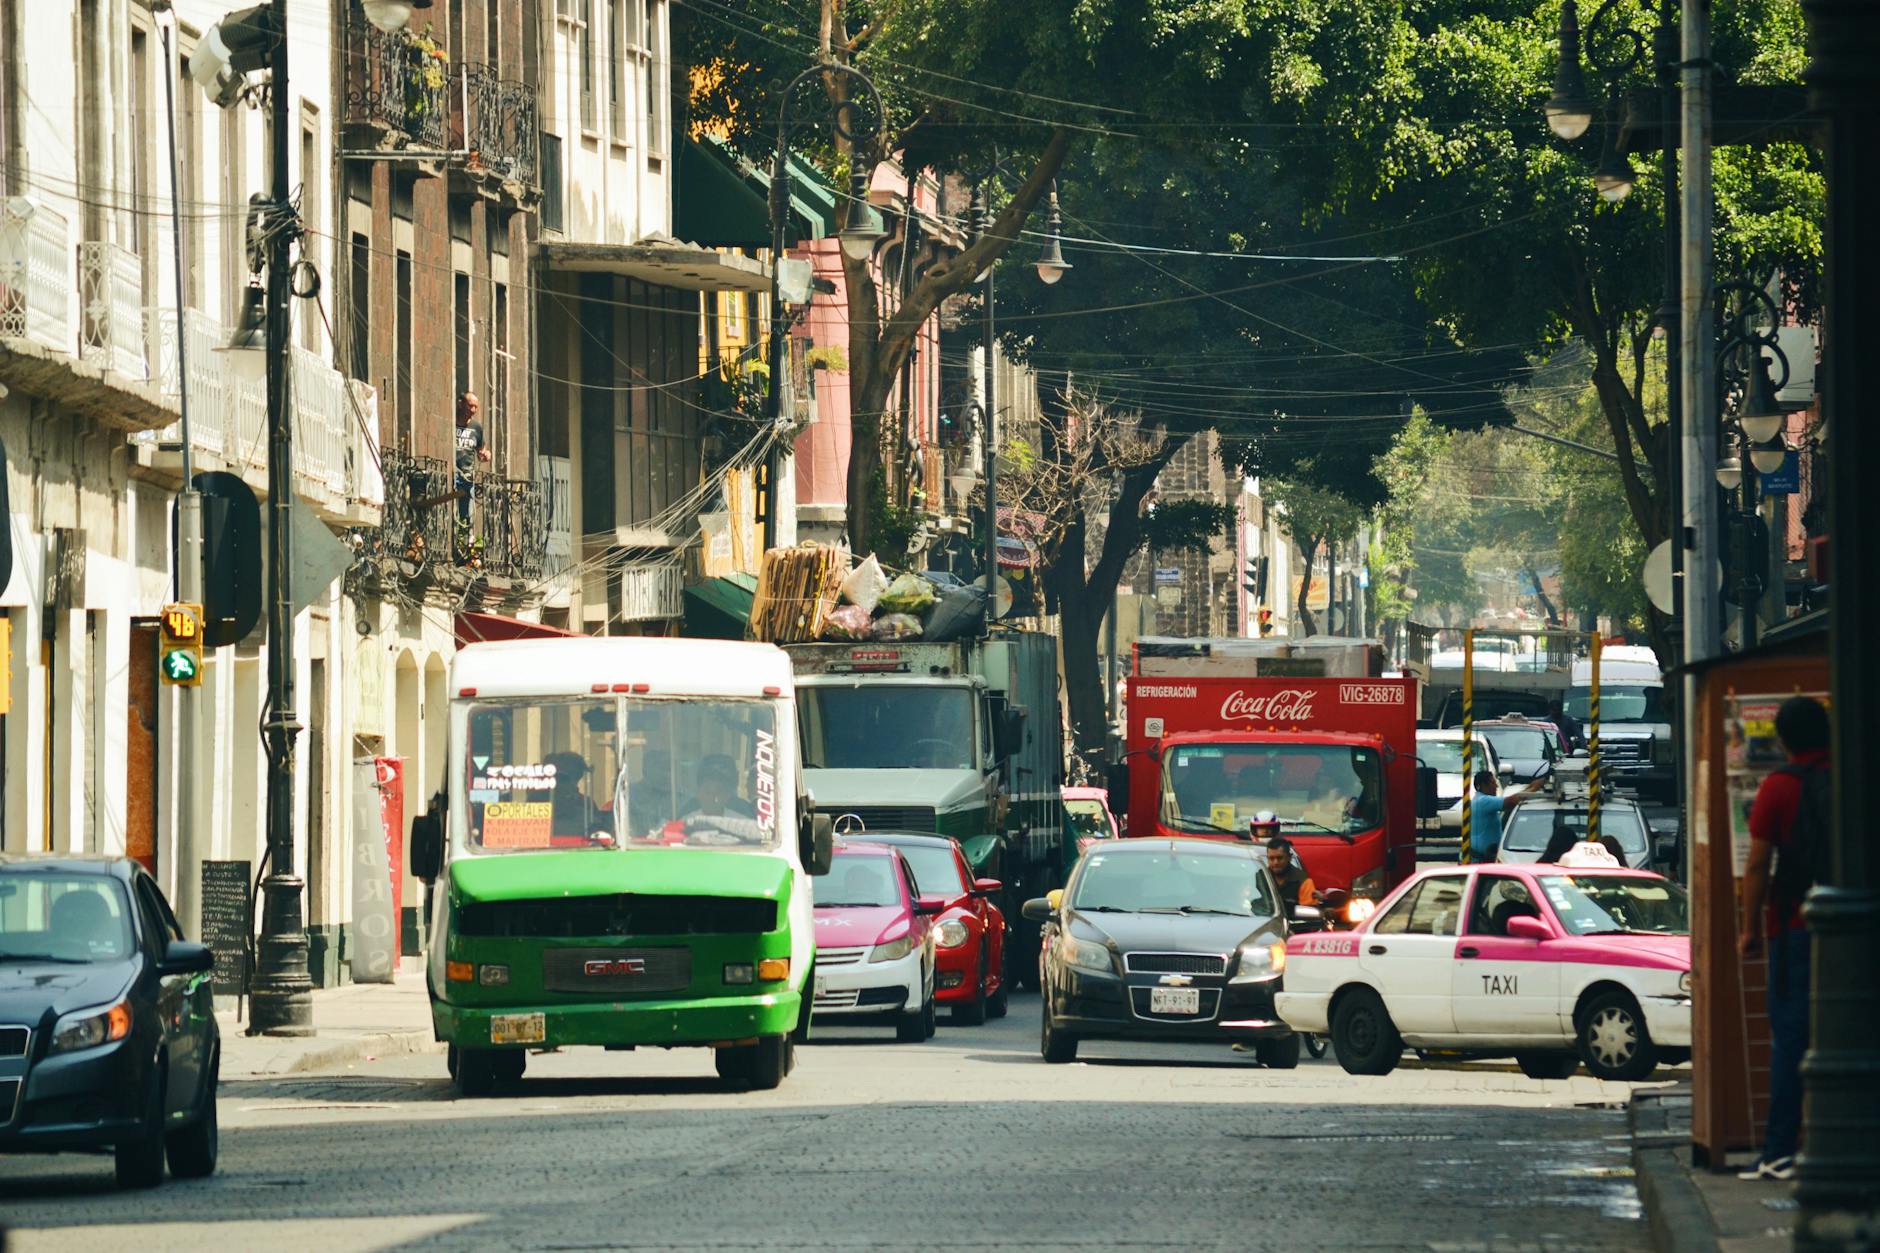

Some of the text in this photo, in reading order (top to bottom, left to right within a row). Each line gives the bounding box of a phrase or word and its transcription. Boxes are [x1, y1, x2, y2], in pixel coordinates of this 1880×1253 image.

[169, 613, 194, 636] 48
[1136, 685, 1197, 698] REFRIGERACIÓN
[1342, 687, 1402, 702] VIG-26878
[1221, 690, 1317, 720] Coca-Cola
[503, 804, 549, 818] PORTALES
[1584, 847, 1605, 857] TAXI
[1302, 940, 1311, 953] A
[585, 959, 645, 975] GMC
[1482, 975, 1518, 995] TAXI
